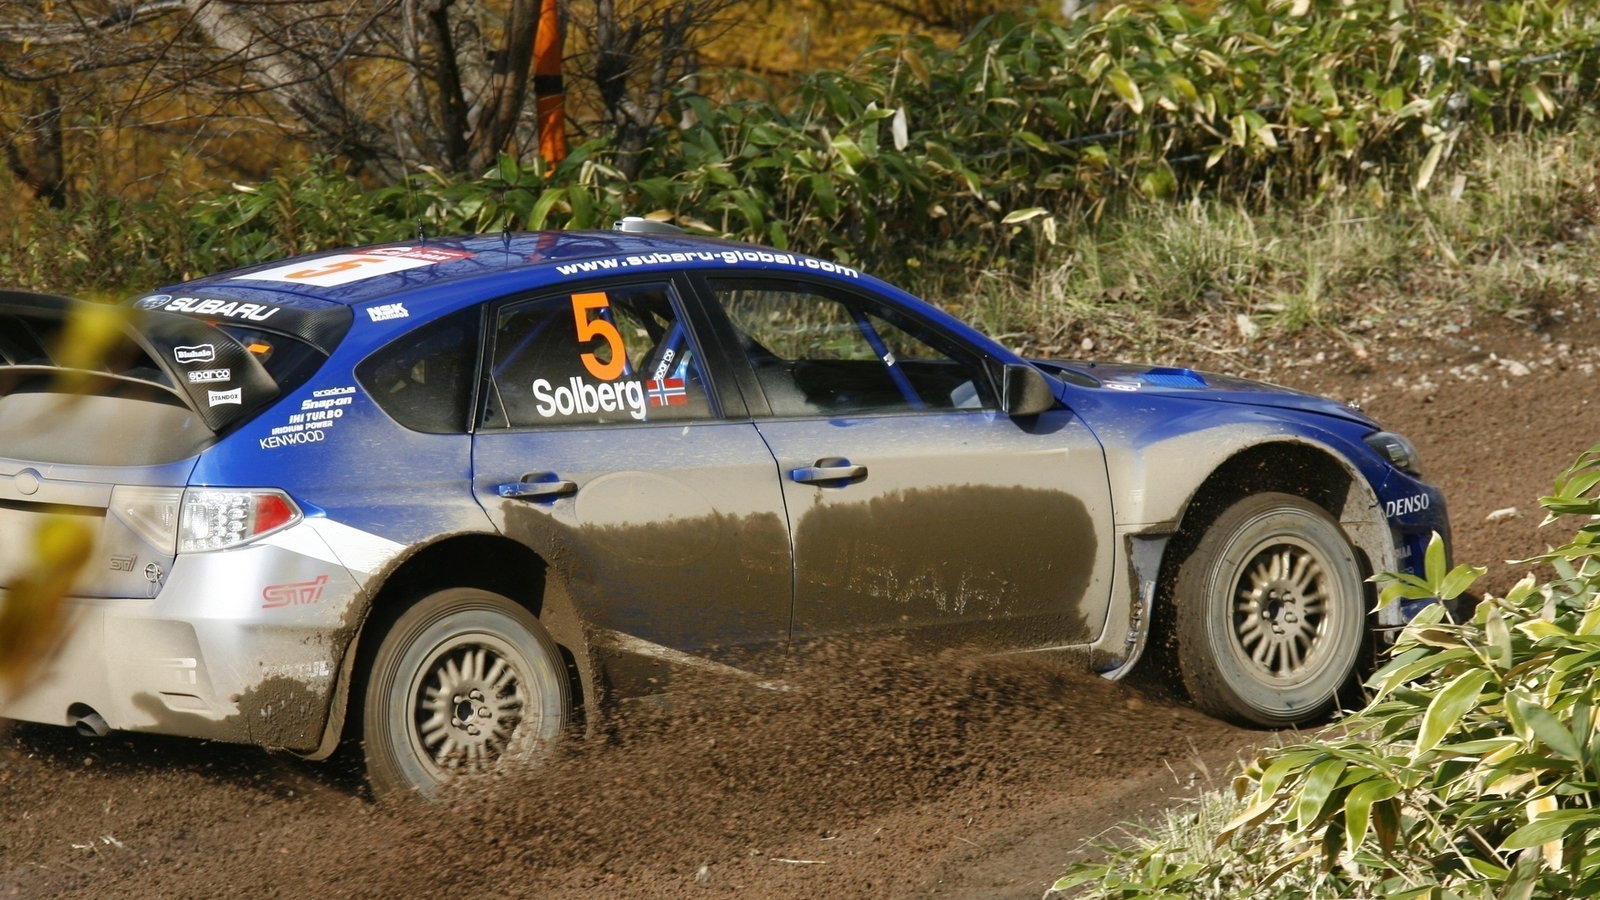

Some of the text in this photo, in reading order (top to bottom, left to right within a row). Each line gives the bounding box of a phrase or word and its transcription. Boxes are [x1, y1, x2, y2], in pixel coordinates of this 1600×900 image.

[285, 257, 388, 279] 5
[556, 250, 859, 278] www.subaru-global.com
[164, 297, 280, 321] SUBARU
[366, 303, 408, 317] NSK
[571, 291, 626, 380] 5
[189, 369, 229, 382] sparco
[211, 394, 238, 402] STANDOX
[301, 397, 352, 410] Snap-on
[532, 376, 648, 420] Solberg
[289, 409, 343, 424] IHI TURBO
[272, 421, 333, 435] IRIDIUM POWER
[259, 430, 325, 449] KENWOOD
[1386, 493, 1429, 518] DENSO
